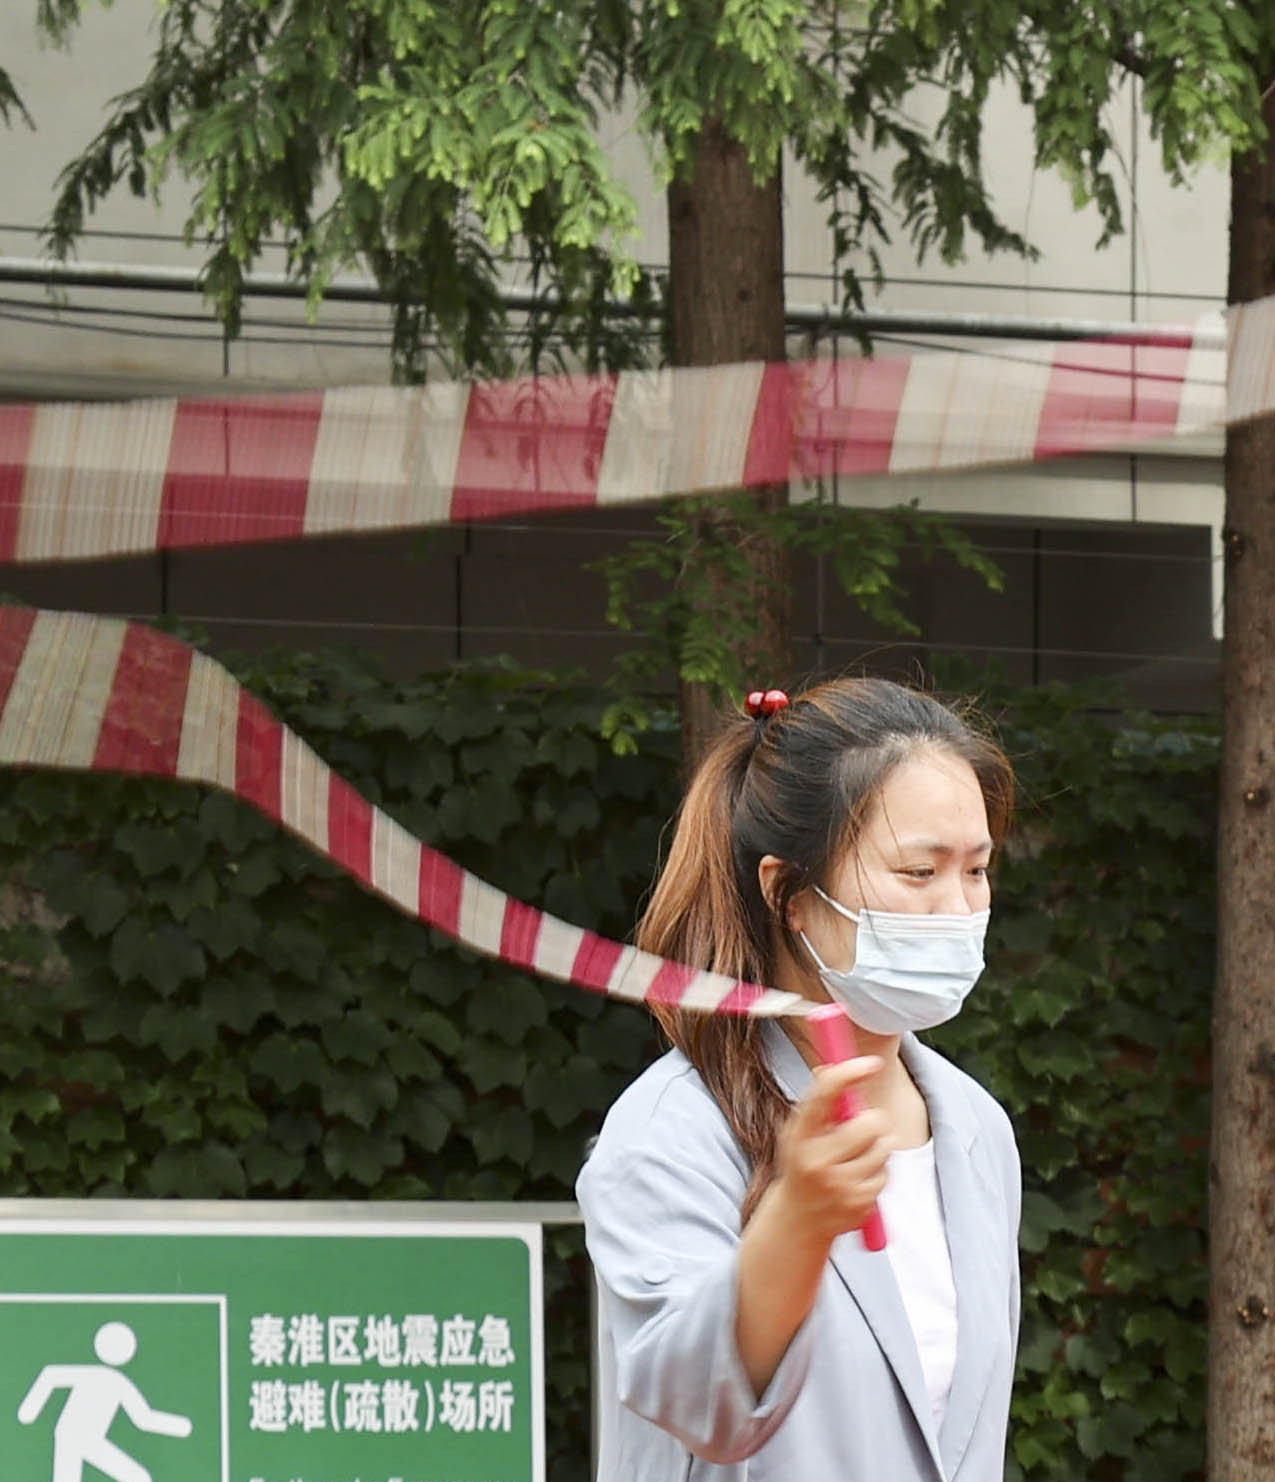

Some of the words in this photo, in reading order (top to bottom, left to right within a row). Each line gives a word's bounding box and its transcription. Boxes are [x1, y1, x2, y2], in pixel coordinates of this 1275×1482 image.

[249, 1313, 516, 1368] 秦淮区地震应急
[249, 1379, 515, 1433] 避难(疏散)场所
